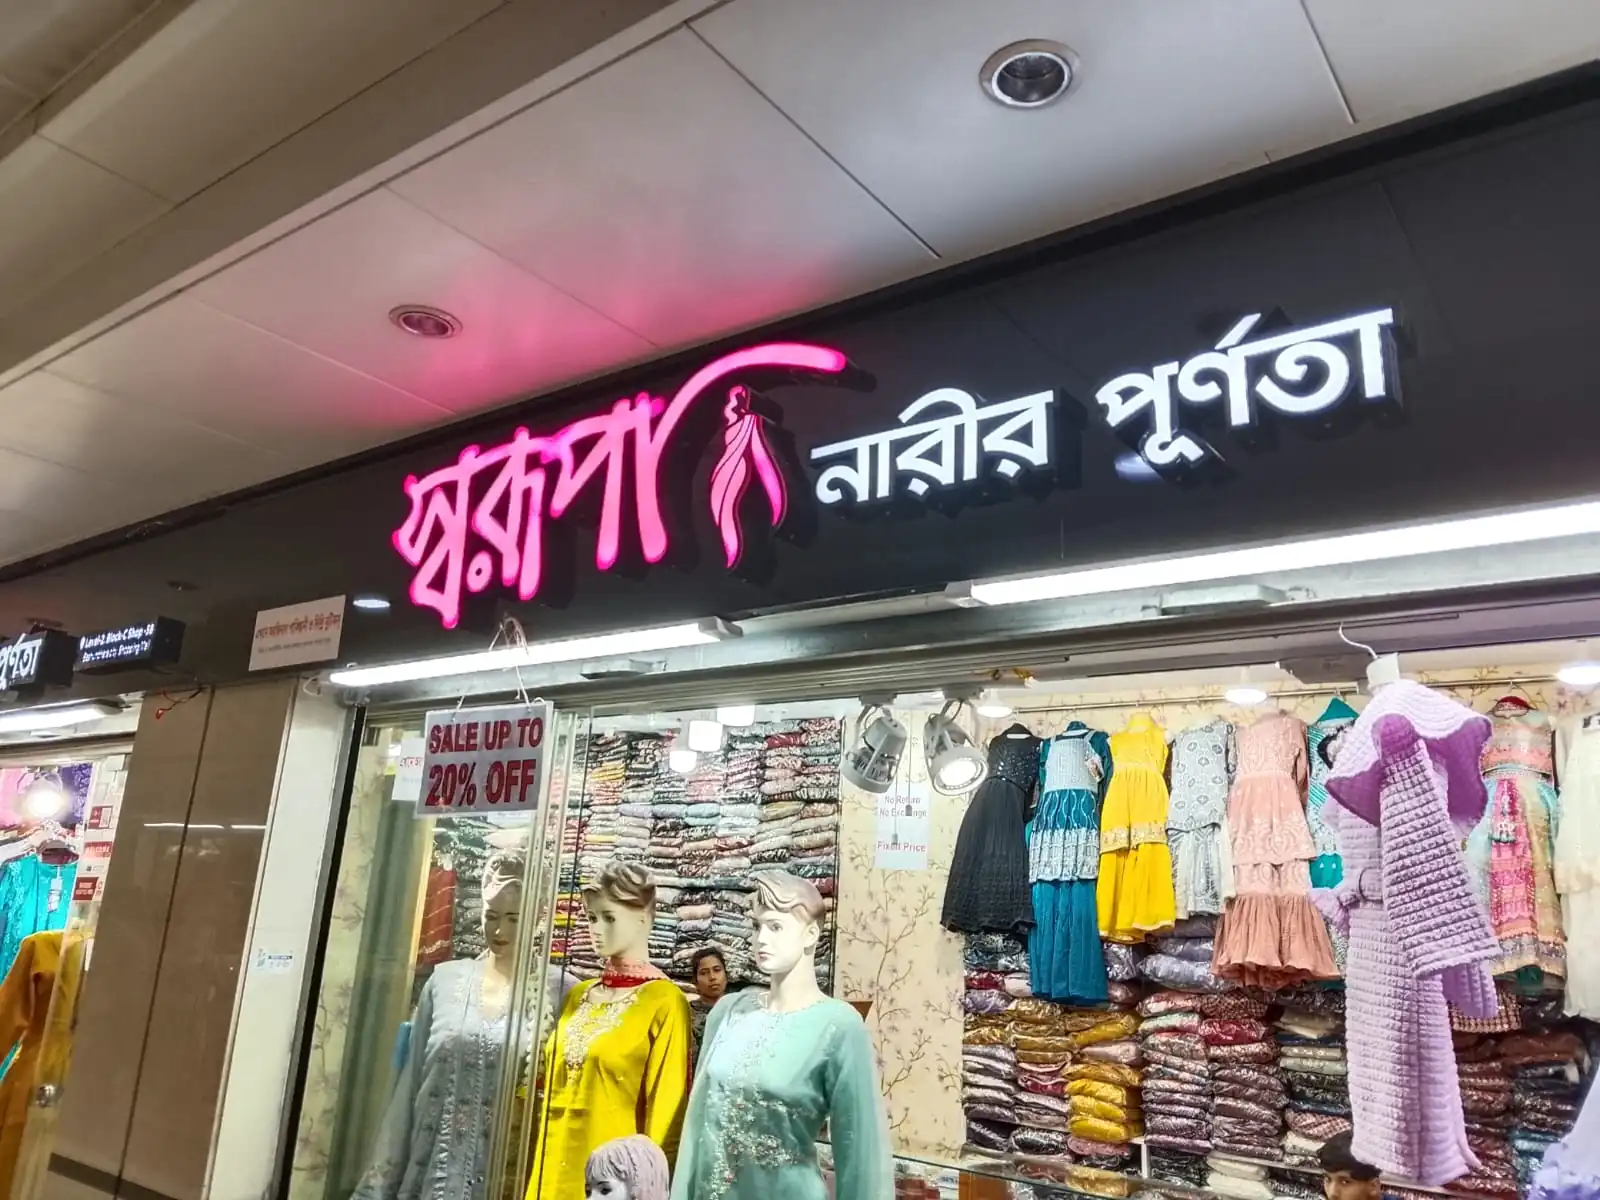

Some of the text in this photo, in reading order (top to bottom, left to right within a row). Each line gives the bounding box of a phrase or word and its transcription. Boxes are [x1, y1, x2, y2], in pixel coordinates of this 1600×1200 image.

[810, 308, 1394, 504] নারীর পূর্ণতা
[428, 716, 544, 754] SALE UP TO
[424, 758, 537, 807] 20% OFF
[884, 795, 895, 804] No
[879, 807, 890, 817] No
[903, 842, 926, 853] Price
